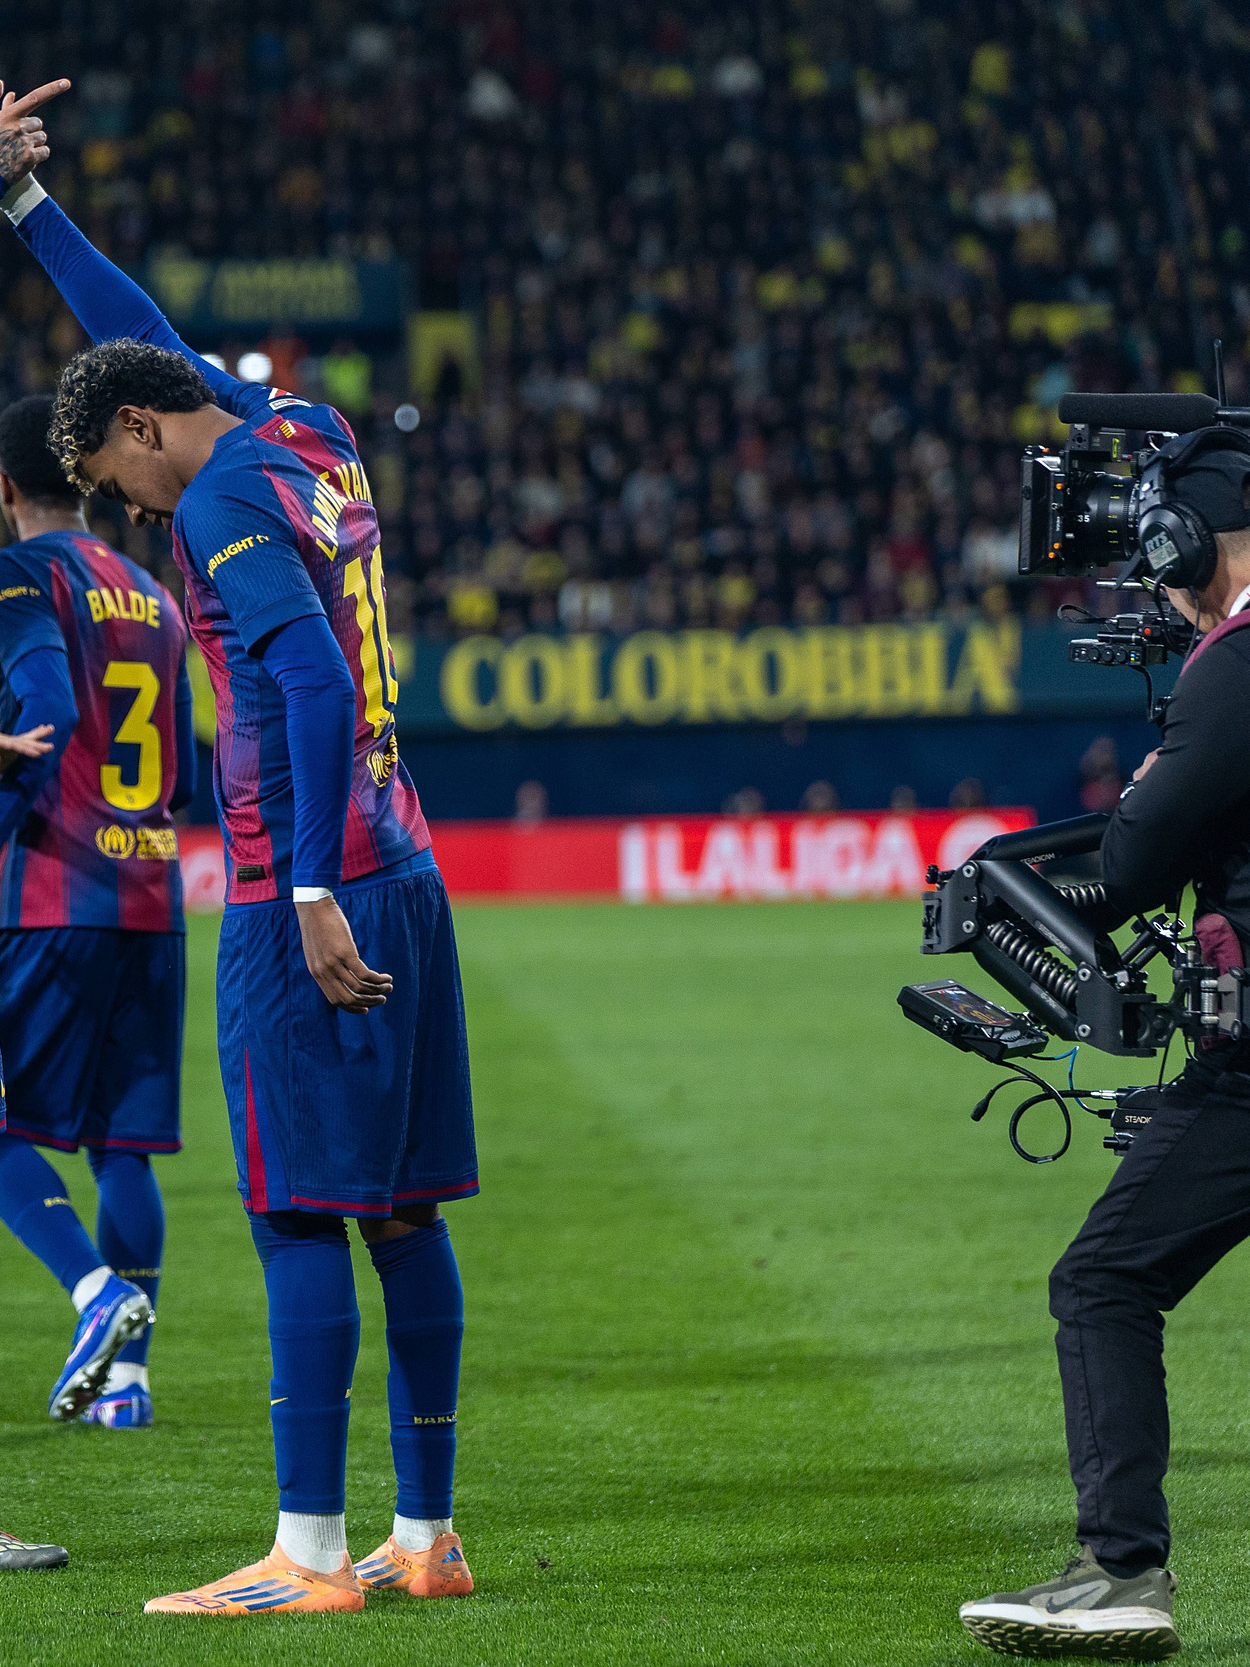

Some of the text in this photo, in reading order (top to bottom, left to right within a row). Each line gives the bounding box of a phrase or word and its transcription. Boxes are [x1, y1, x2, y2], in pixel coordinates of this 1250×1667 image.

[86, 587, 160, 628] BALDE
[442, 621, 1021, 731] COLOROBBIA
[101, 661, 162, 810] 3
